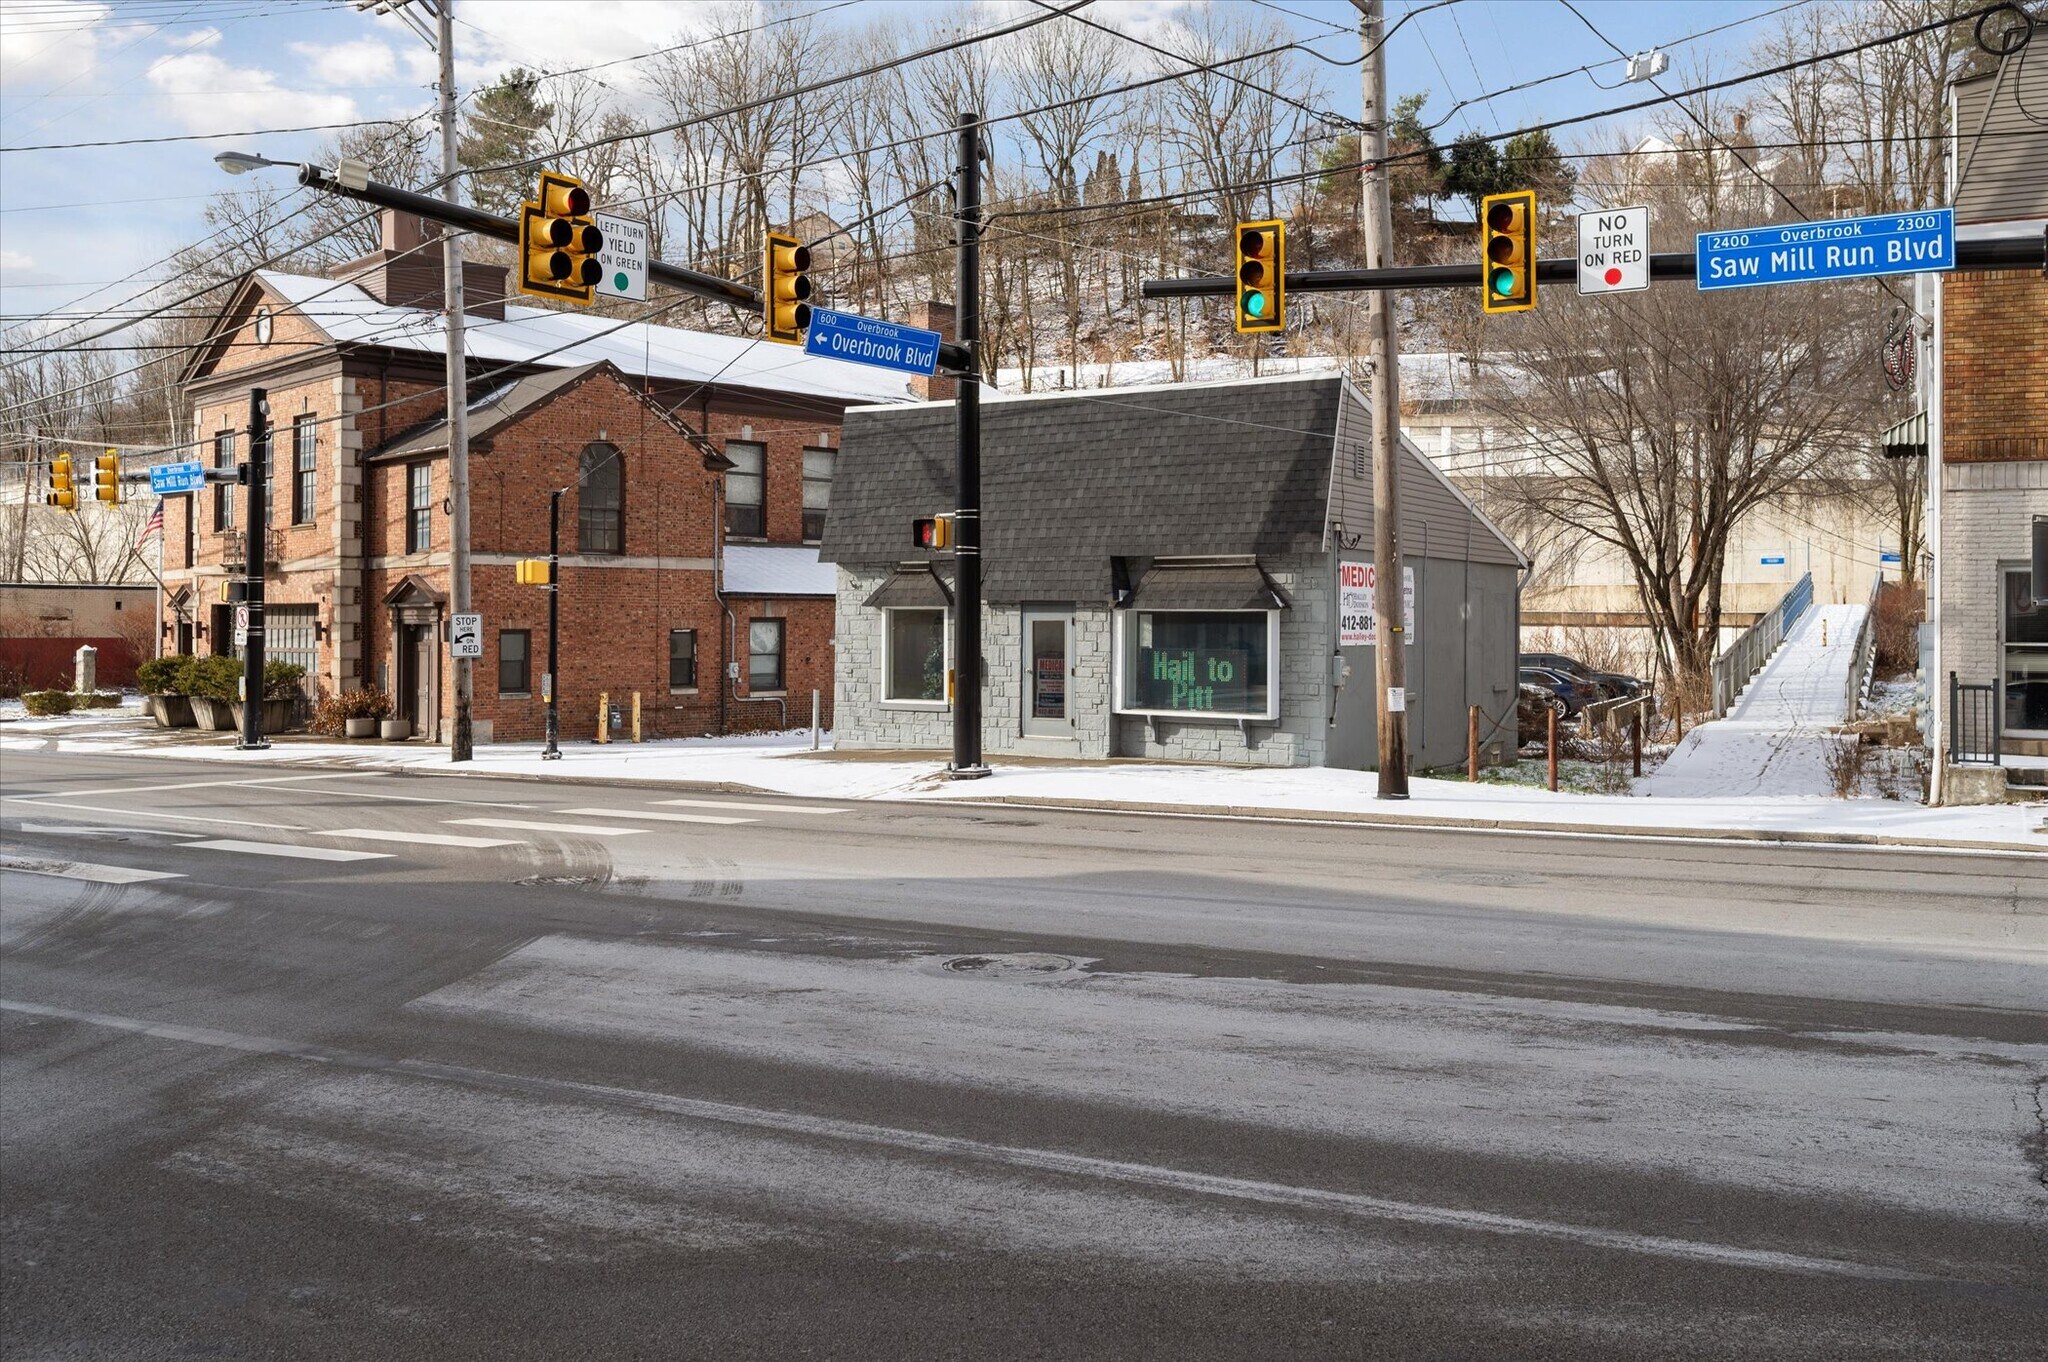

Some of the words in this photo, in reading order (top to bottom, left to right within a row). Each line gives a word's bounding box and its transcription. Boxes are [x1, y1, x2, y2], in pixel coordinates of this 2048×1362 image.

[600, 221, 619, 234] LEFT
[623, 225, 643, 239] TURN
[1599, 215, 1627, 232] NO
[1713, 235, 1749, 249] 2400
[1781, 223, 1862, 242] Overbrook
[1897, 216, 1936, 231] 2300
[609, 238, 635, 254] YIELD
[1593, 233, 1633, 249] TURN
[601, 253, 612, 265] ON
[616, 256, 642, 271] GREEN
[1585, 253, 1604, 267] ON
[1613, 249, 1642, 264] RED
[1710, 256, 1760, 279] Saw
[1771, 247, 1815, 273] Mill
[1826, 245, 1875, 268] Run
[1887, 235, 1943, 263] Blvd
[820, 313, 837, 325] 600
[857, 321, 899, 338] Overbrook
[832, 333, 901, 362] Overbrook
[905, 347, 933, 368] Blvd
[153, 478, 165, 489] Saw
[177, 475, 189, 486] Run
[455, 617, 477, 625] STOP
[463, 645, 479, 653] RED
[1154, 651, 1195, 681] Hail
[1208, 657, 1233, 682] to
[1172, 680, 1213, 709] Pitt
